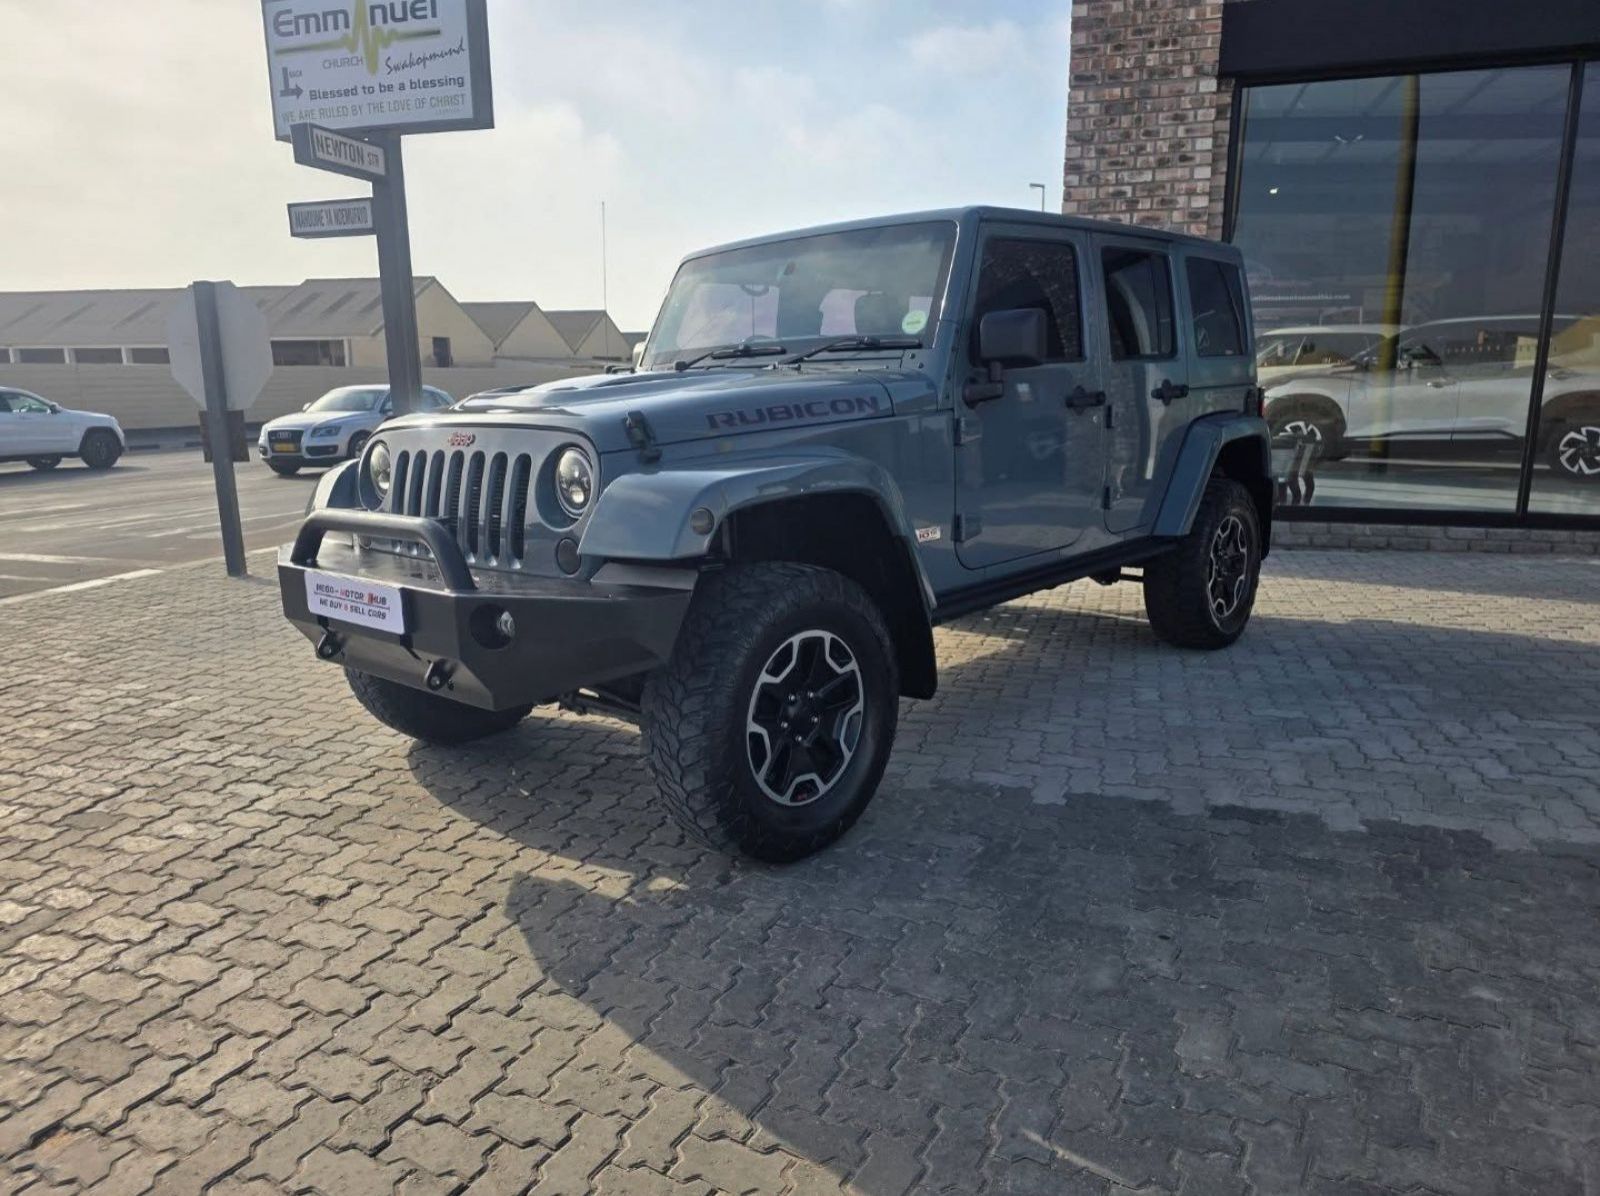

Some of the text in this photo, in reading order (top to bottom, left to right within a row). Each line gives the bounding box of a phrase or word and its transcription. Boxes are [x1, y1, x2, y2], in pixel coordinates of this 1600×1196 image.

[322, 57, 364, 69] CHURCH
[385, 37, 465, 75] Swakopmund
[309, 76, 464, 100] Blessed to be a blessing
[319, 105, 349, 119] RULED
[351, 103, 363, 116] BY
[368, 101, 384, 114] THE
[388, 99, 411, 113] LOVE
[415, 97, 426, 110] OF
[429, 94, 466, 109] CHRIST
[315, 133, 364, 165] NEWTON
[705, 396, 880, 429] RUBICON
[320, 598, 328, 606] WE
[329, 600, 342, 609] BUY
[349, 604, 365, 615] SELL
[367, 609, 387, 620] CARS
